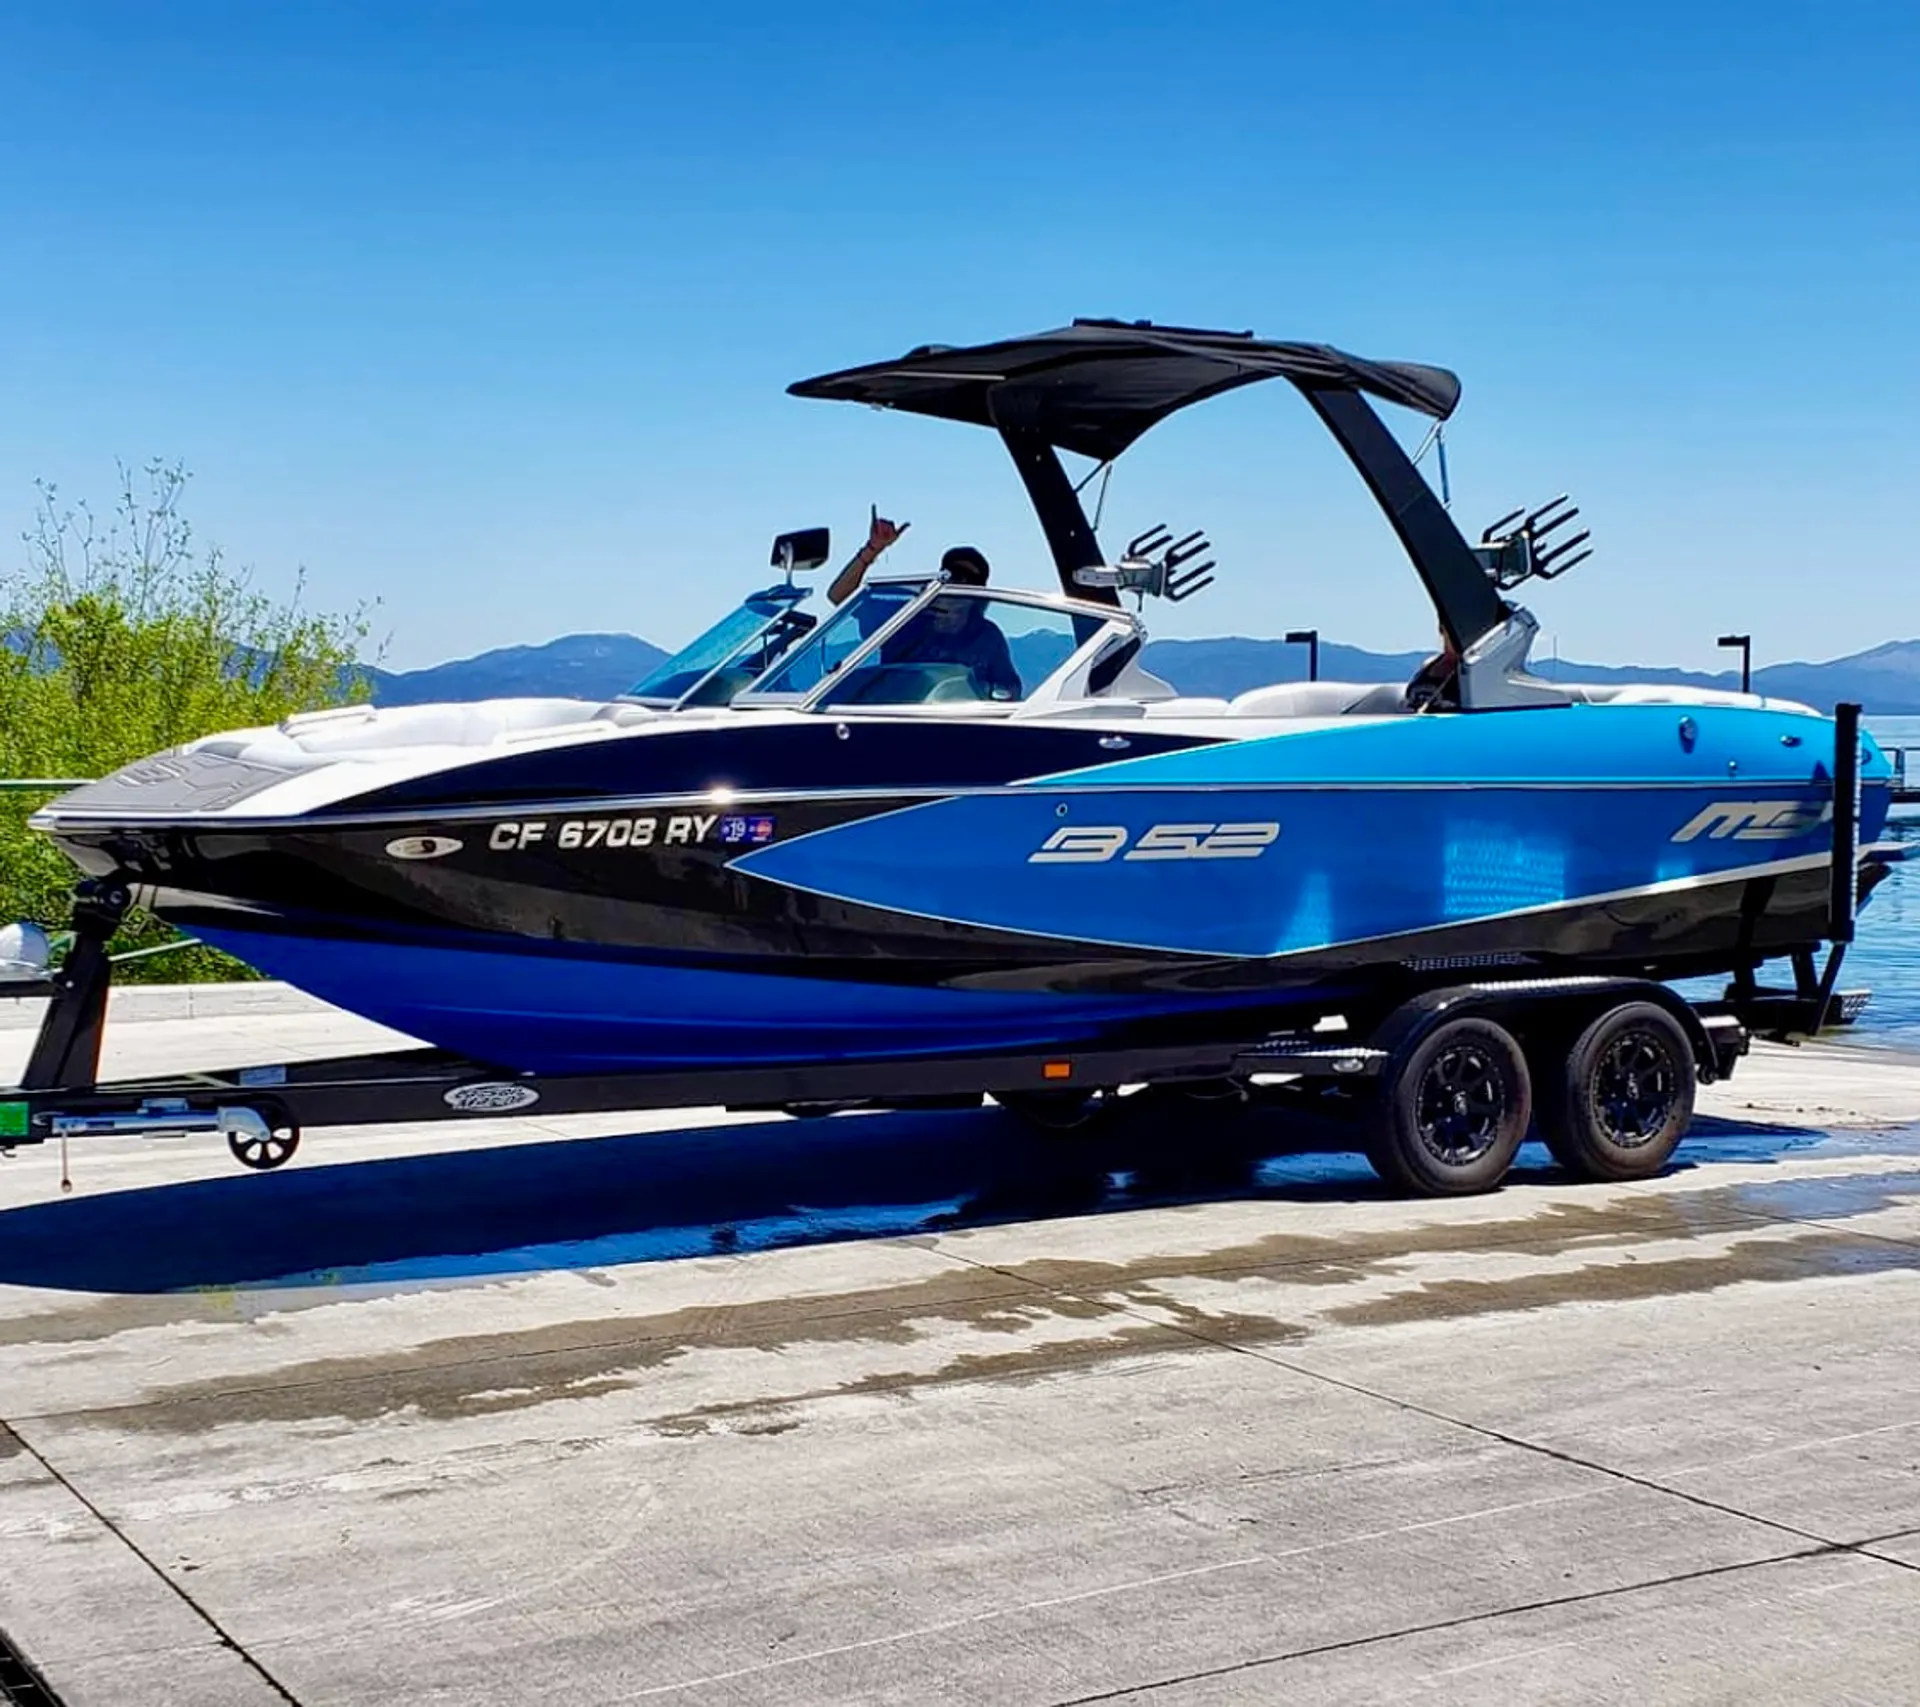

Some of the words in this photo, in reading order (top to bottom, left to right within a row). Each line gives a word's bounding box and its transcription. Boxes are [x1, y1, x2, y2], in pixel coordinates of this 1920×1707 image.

[488, 822, 547, 850] CF
[558, 817, 658, 849] 6708
[664, 814, 718, 845] RY
